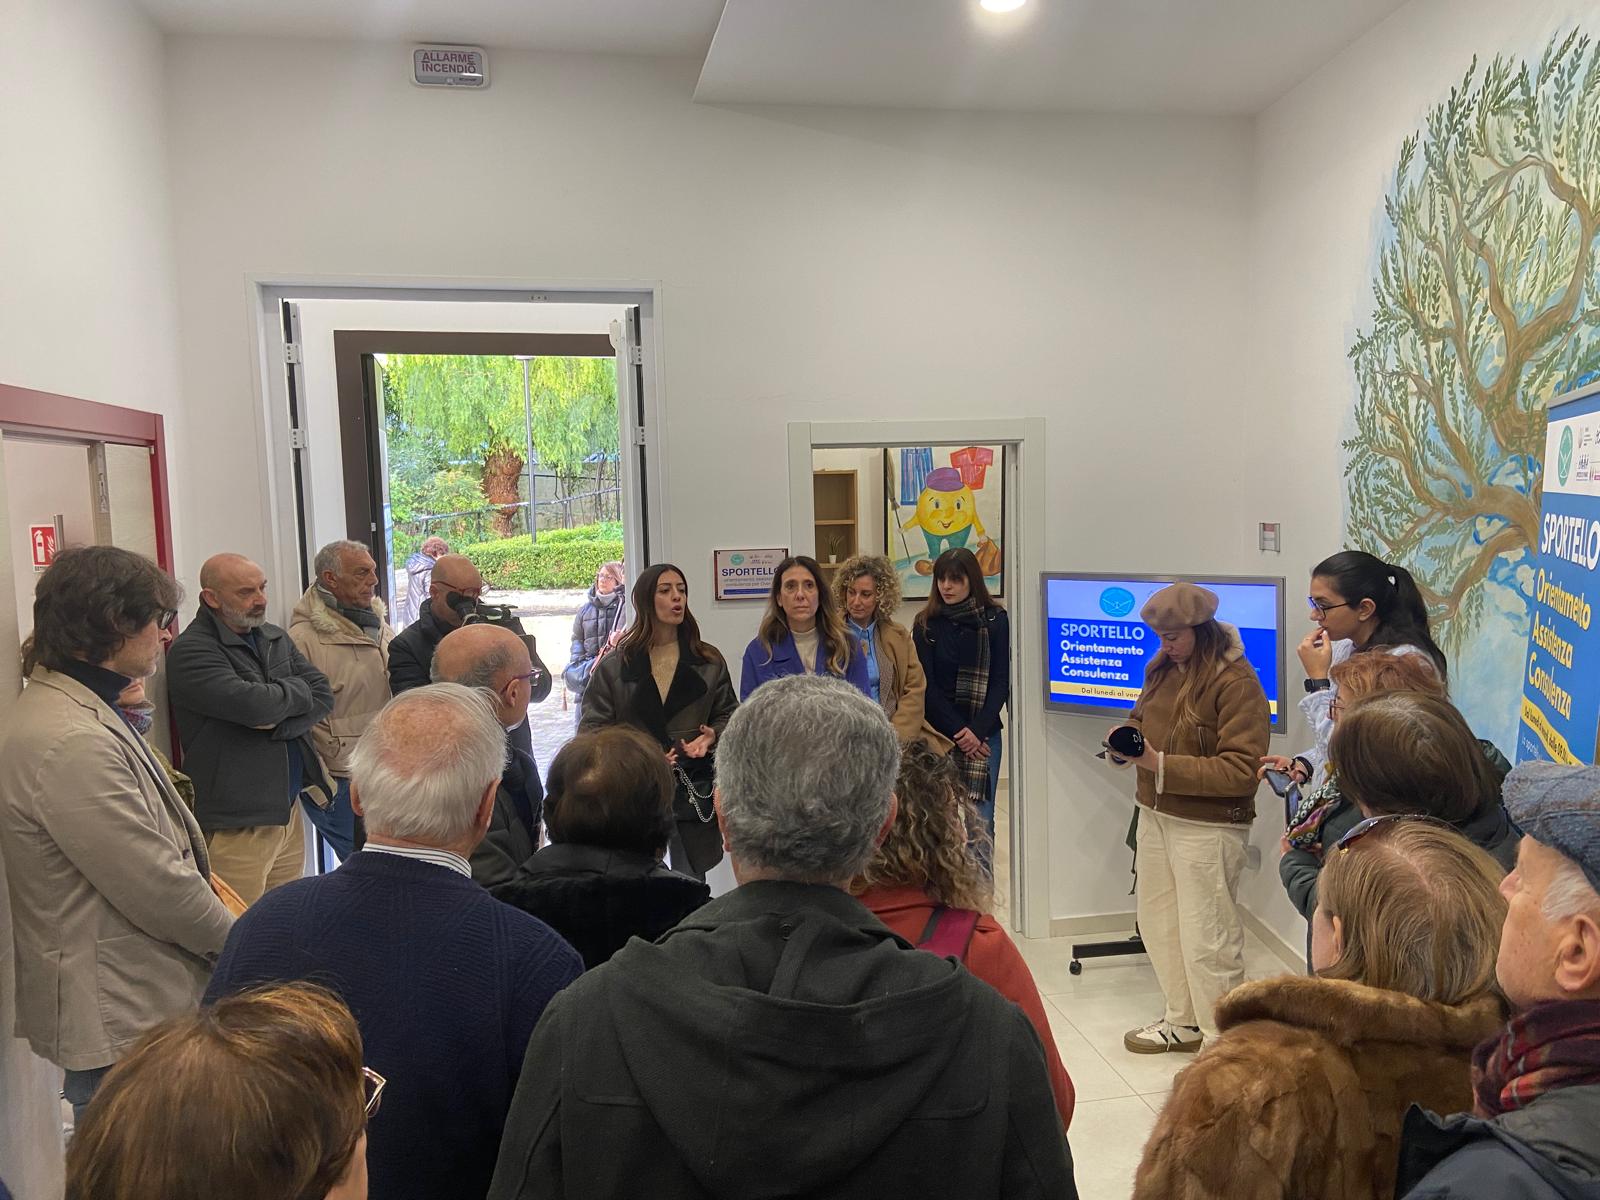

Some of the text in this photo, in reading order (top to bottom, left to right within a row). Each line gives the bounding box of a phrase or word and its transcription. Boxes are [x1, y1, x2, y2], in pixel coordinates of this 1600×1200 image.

[422, 52, 474, 63] ALLARME
[422, 63, 476, 74] INCENDIO
[1541, 512, 1600, 571] SPORTELLO
[1060, 623, 1145, 640] SPORTELLO
[1531, 610, 1574, 669] Assistenza
[1060, 640, 1144, 655] Orientamento
[1060, 653, 1122, 667] Assistenza
[1061, 665, 1129, 680] Consulenza
